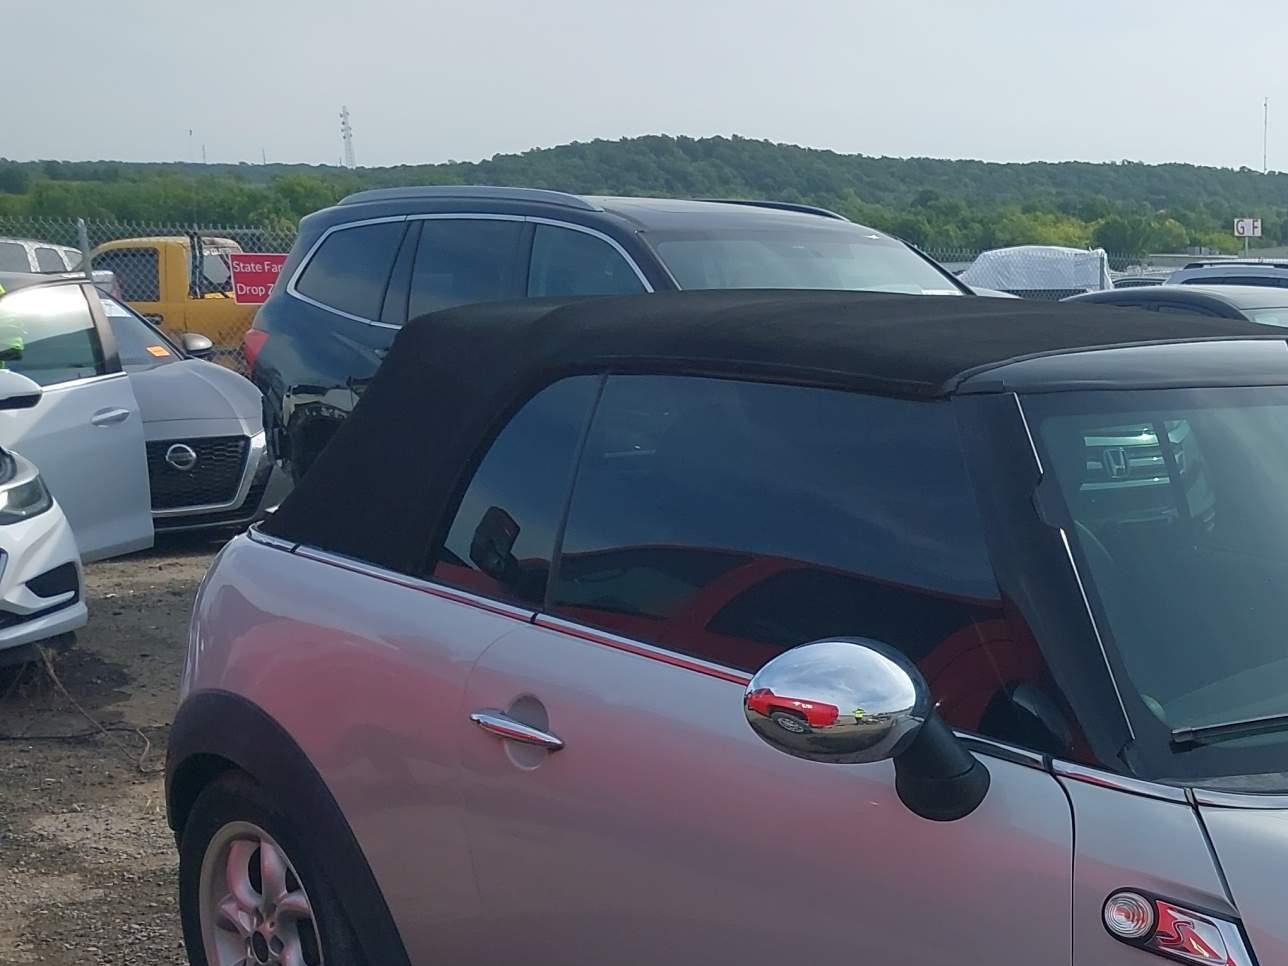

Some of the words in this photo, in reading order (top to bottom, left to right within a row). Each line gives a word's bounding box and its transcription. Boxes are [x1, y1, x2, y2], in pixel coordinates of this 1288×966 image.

[1236, 219, 1246, 236] G
[1252, 219, 1260, 236] F
[233, 260, 263, 273] State
[264, 261, 284, 273] Far
[236, 283, 266, 297] Drop
